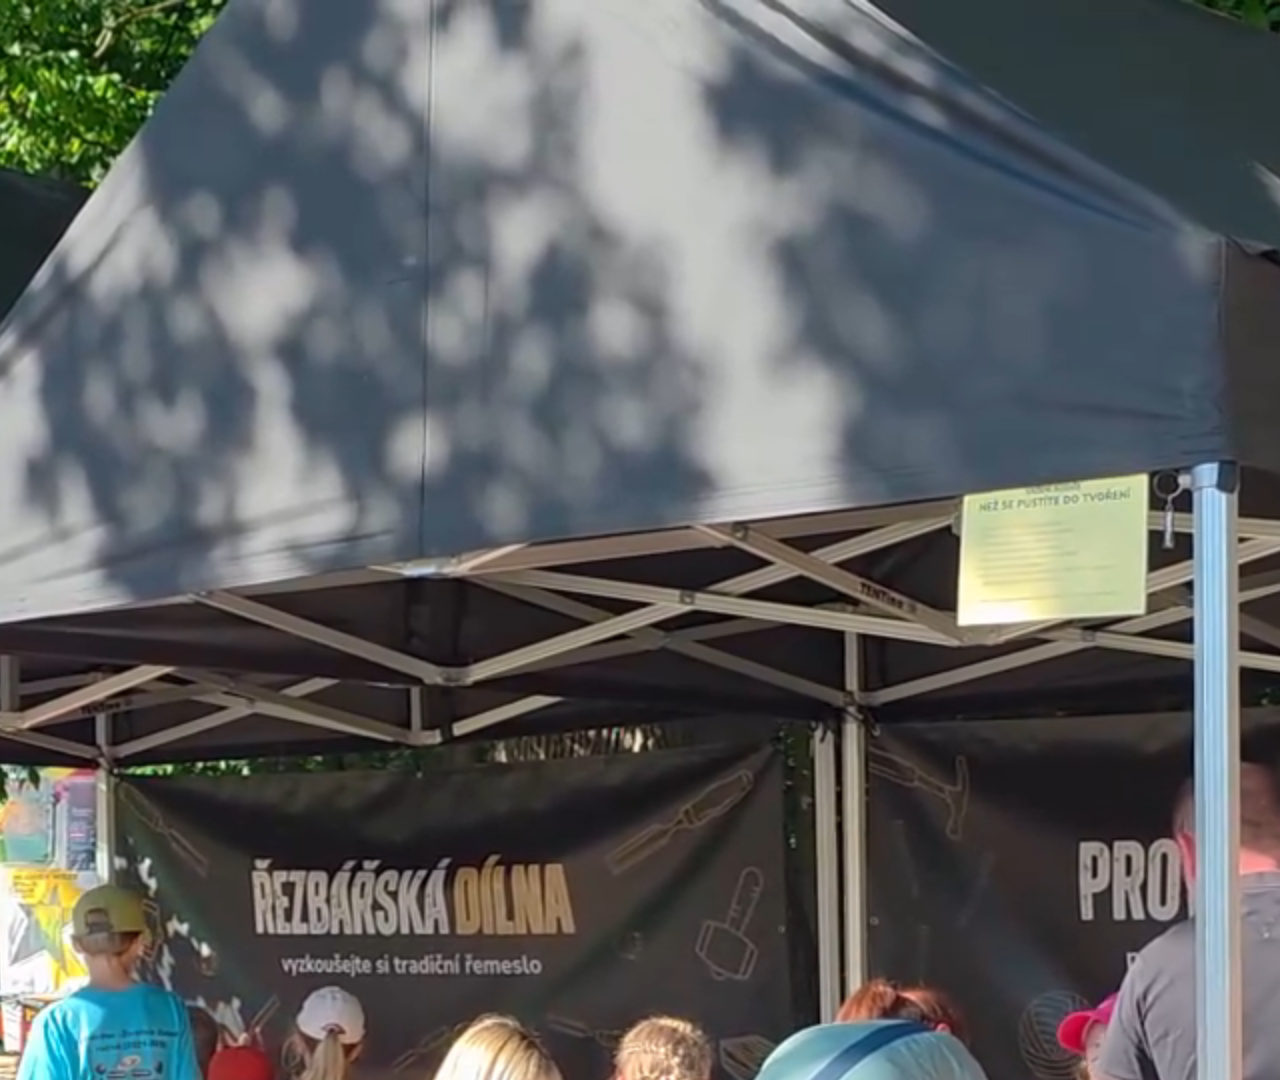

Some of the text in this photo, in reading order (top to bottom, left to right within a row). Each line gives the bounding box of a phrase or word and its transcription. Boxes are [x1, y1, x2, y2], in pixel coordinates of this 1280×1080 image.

[1001, 500, 1014, 511] SE
[1063, 494, 1080, 506] DO
[251, 854, 576, 937] ŘEZBÁŘSKÁ DÍLNA
[281, 952, 543, 978] vyzkoušejte si tradiční řemeslo
